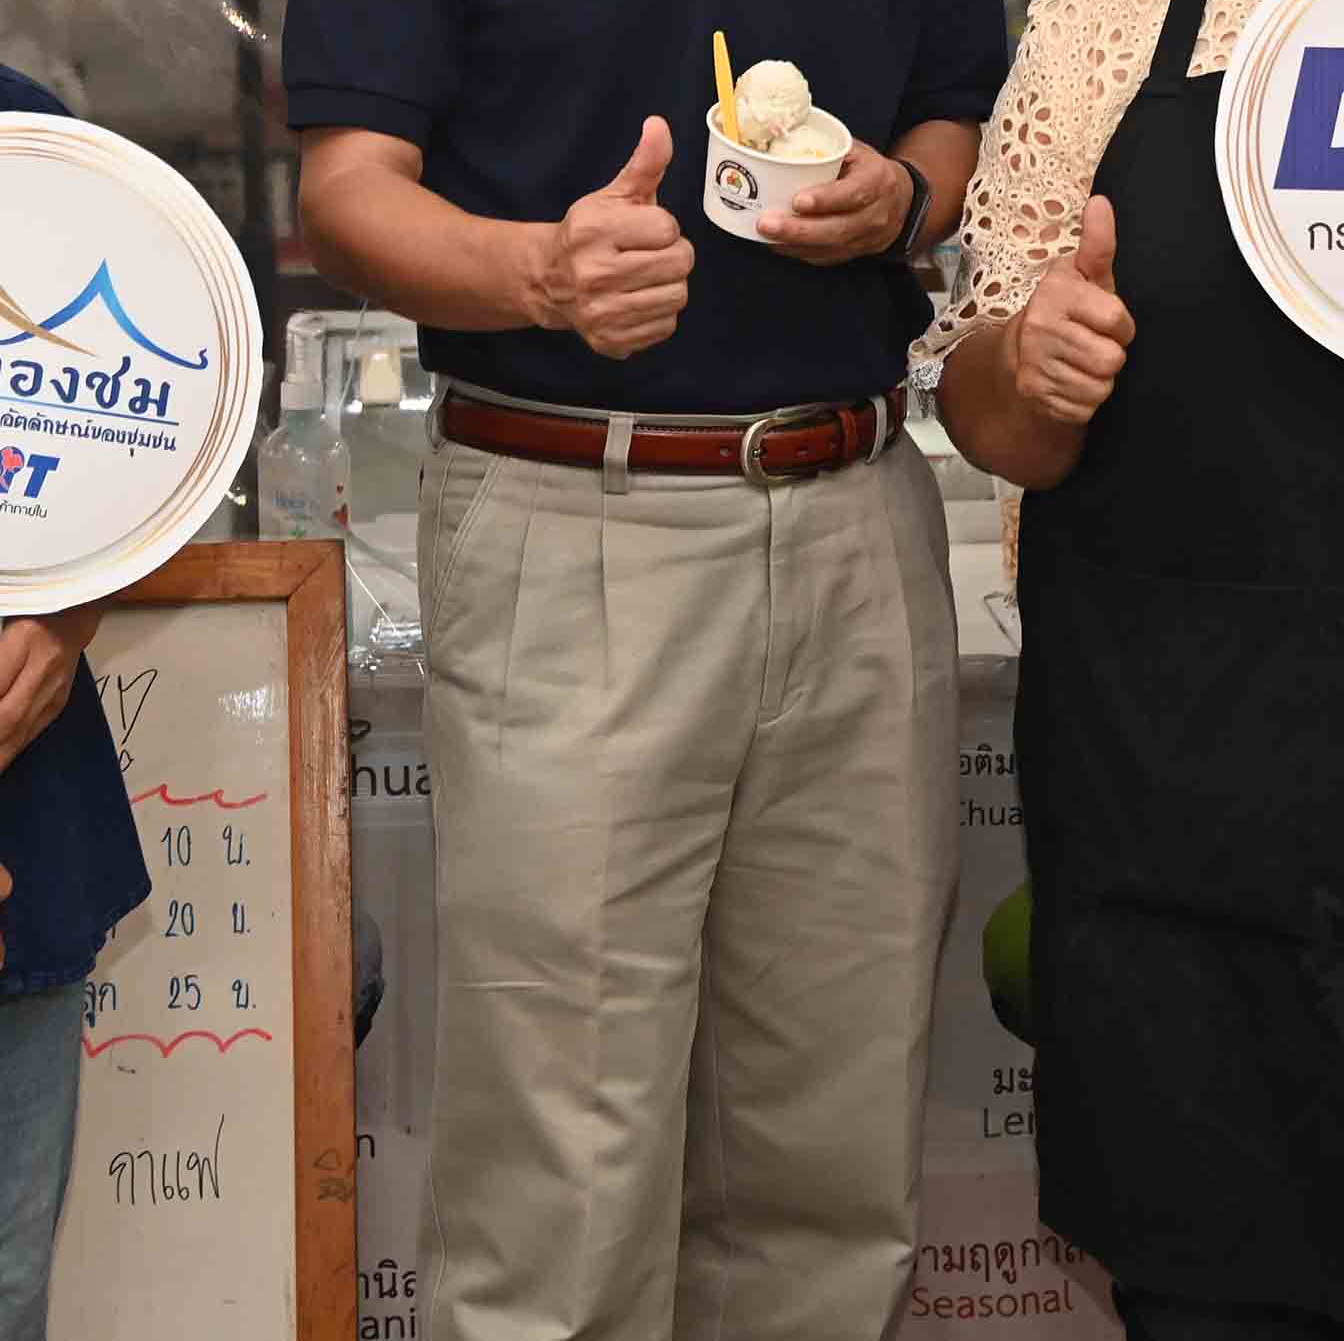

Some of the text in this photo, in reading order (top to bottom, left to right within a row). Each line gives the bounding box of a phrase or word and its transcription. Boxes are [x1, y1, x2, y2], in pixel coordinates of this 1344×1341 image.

[0, 408, 177, 458] อัตลักษณ์ของชุมชน
[160, 825, 251, 867] 10 บ.
[164, 899, 195, 938] 20
[167, 974, 202, 1011] 25
[231, 978, 257, 1010] บ.
[108, 1113, 225, 1206] กาแฟ
[911, 1279, 1075, 1320] Seasonal
